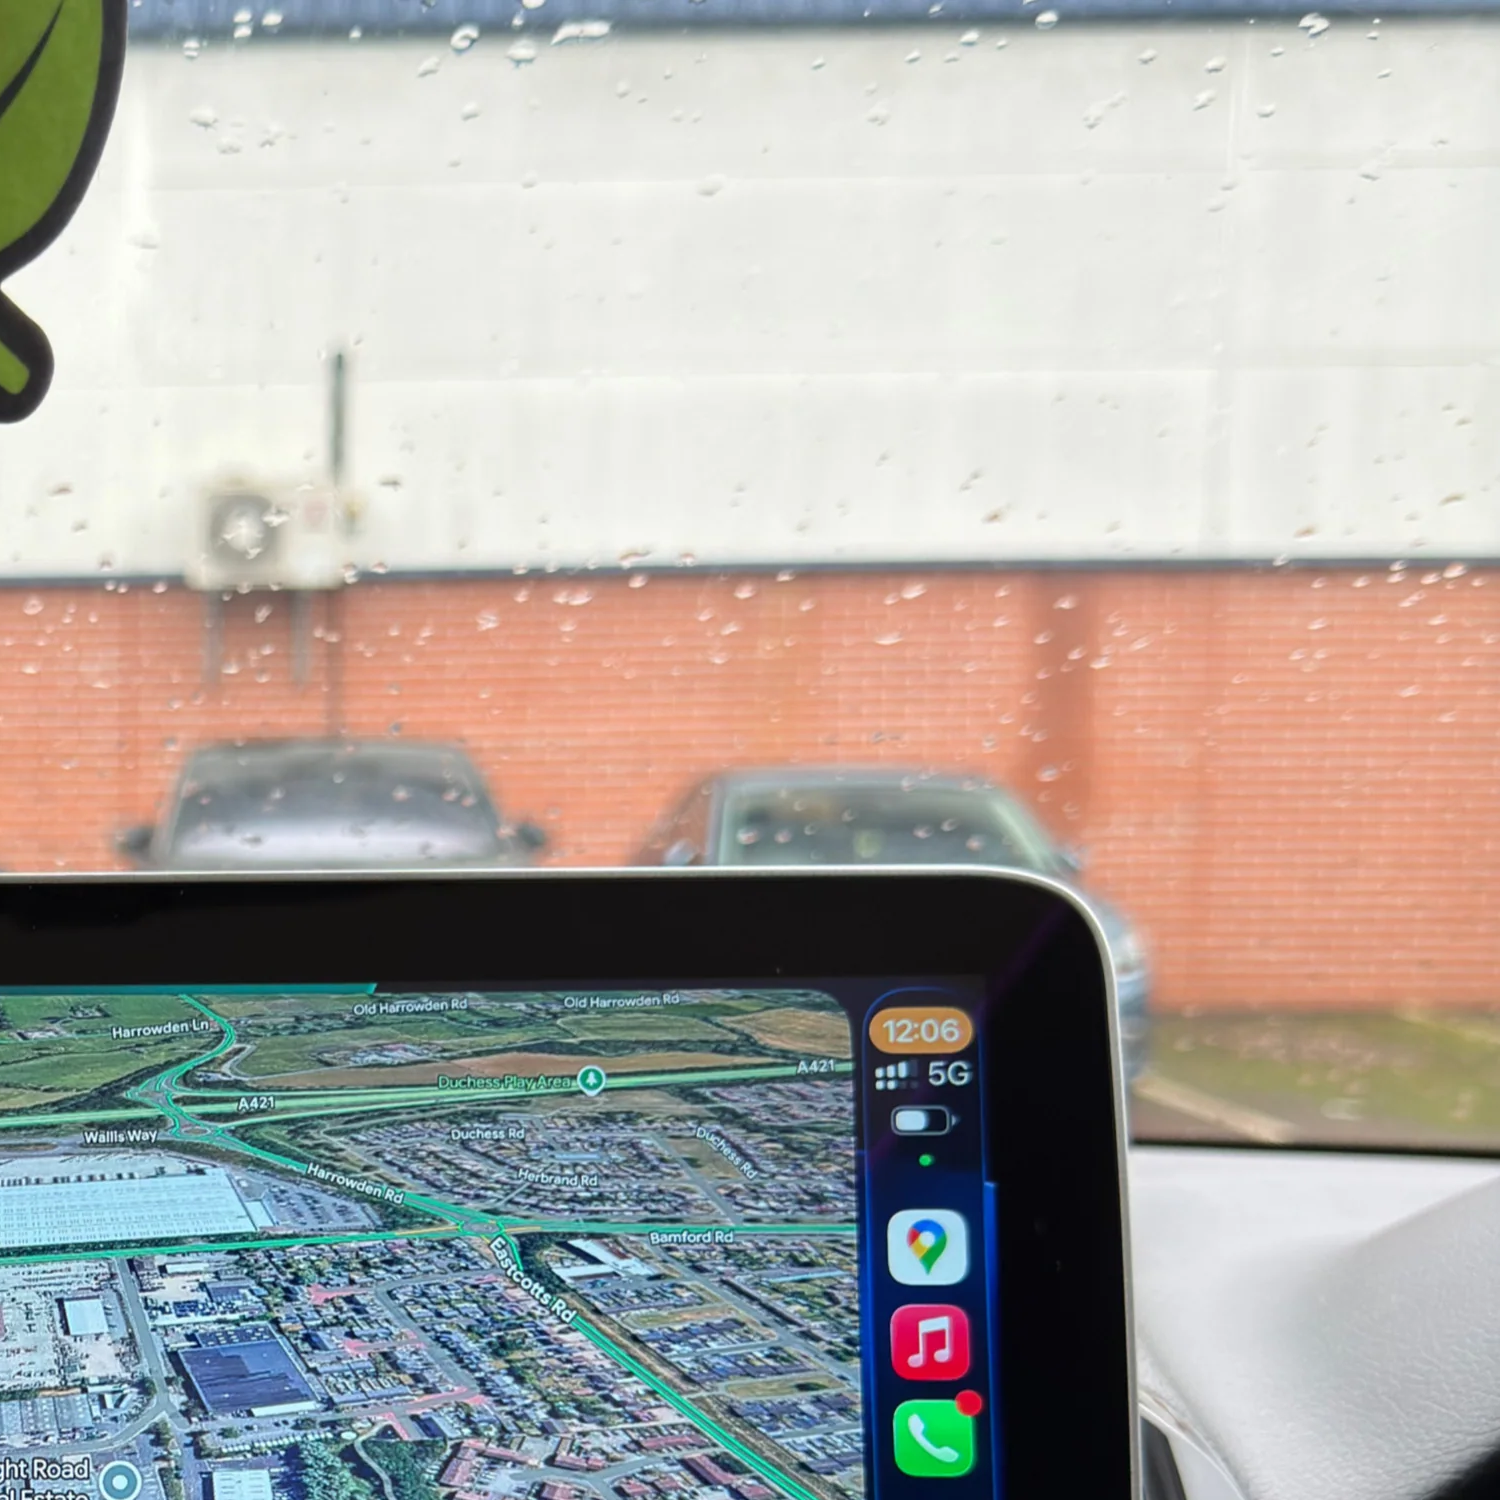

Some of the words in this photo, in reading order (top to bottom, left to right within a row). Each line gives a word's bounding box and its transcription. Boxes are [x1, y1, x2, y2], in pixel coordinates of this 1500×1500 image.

[353, 1003, 377, 1016] Old
[378, 999, 449, 1015] Harrowden
[450, 997, 468, 1010] Rd
[563, 996, 588, 1009] Old
[589, 994, 661, 1008] Harrowden
[662, 993, 680, 1006] Rd
[111, 1021, 189, 1039] Harrowden
[190, 1019, 210, 1033] Ln
[882, 1018, 961, 1043] 12:06
[796, 1059, 836, 1074] A421
[928, 1061, 972, 1086] 5G
[437, 1075, 501, 1090] Duchess
[503, 1074, 536, 1091] Play
[536, 1074, 571, 1089] Area
[237, 1096, 276, 1112] A421
[83, 1130, 125, 1145] Wallis
[126, 1129, 158, 1145] Way
[450, 1128, 506, 1141] Duchess
[507, 1127, 525, 1140] Rd
[695, 1126, 741, 1168] Duchess
[737, 1159, 759, 1181] Rd
[306, 1162, 382, 1198] Harrowden
[383, 1187, 405, 1205] Rd
[518, 1168, 579, 1187] Herbrand
[579, 1174, 599, 1187] Rd
[649, 1231, 713, 1246] Bamford
[713, 1230, 735, 1245] Rd
[489, 1236, 553, 1307] Eastcotts
[551, 1297, 578, 1325] Rd
[32, 1457, 90, 1481] Road
